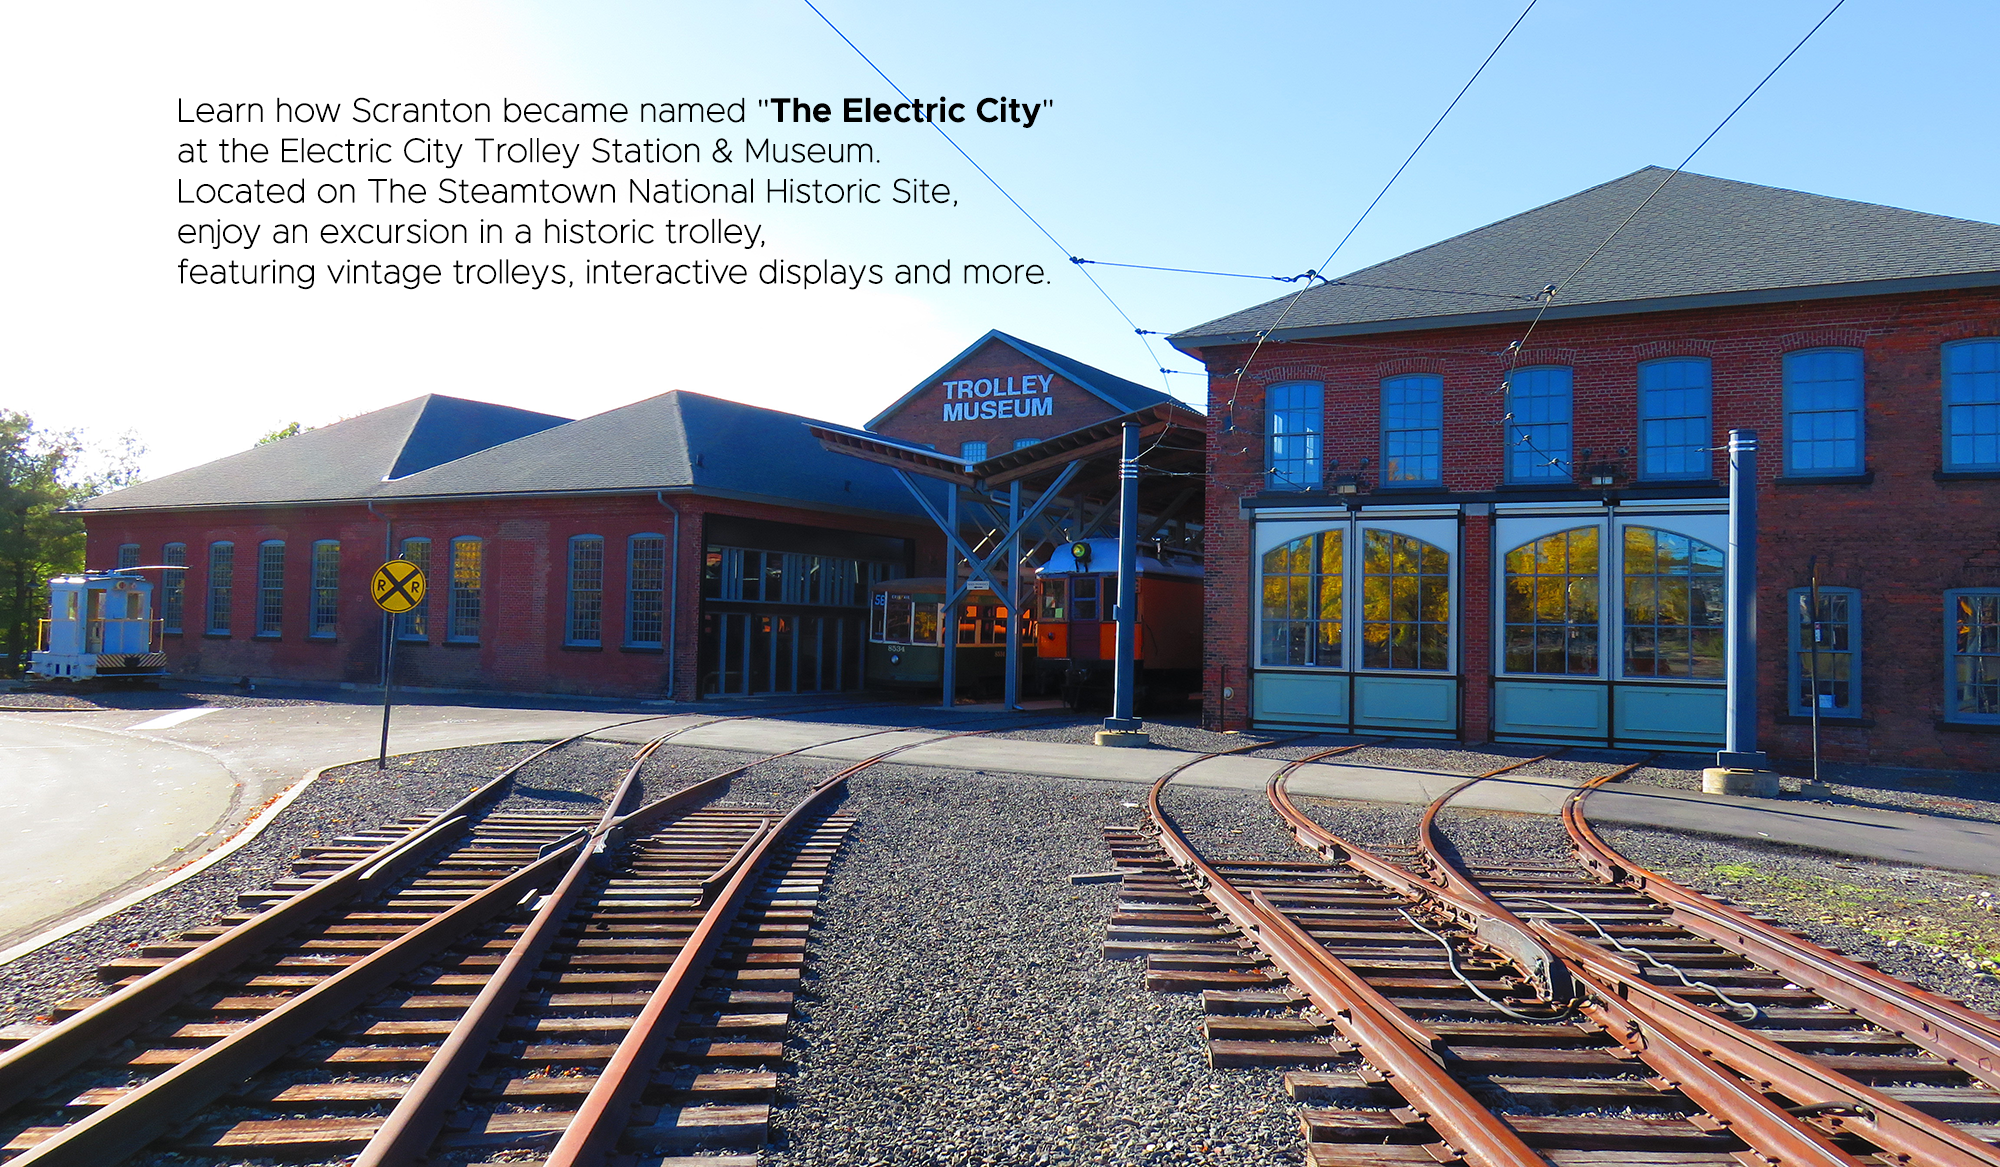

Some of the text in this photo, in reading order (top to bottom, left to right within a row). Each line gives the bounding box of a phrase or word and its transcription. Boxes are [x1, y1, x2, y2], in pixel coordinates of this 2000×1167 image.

[942, 373, 1054, 400] TROLLEY
[943, 396, 1053, 422] MUSEUM
[377, 579, 420, 593] R R
[887, 644, 905, 652] 8534
